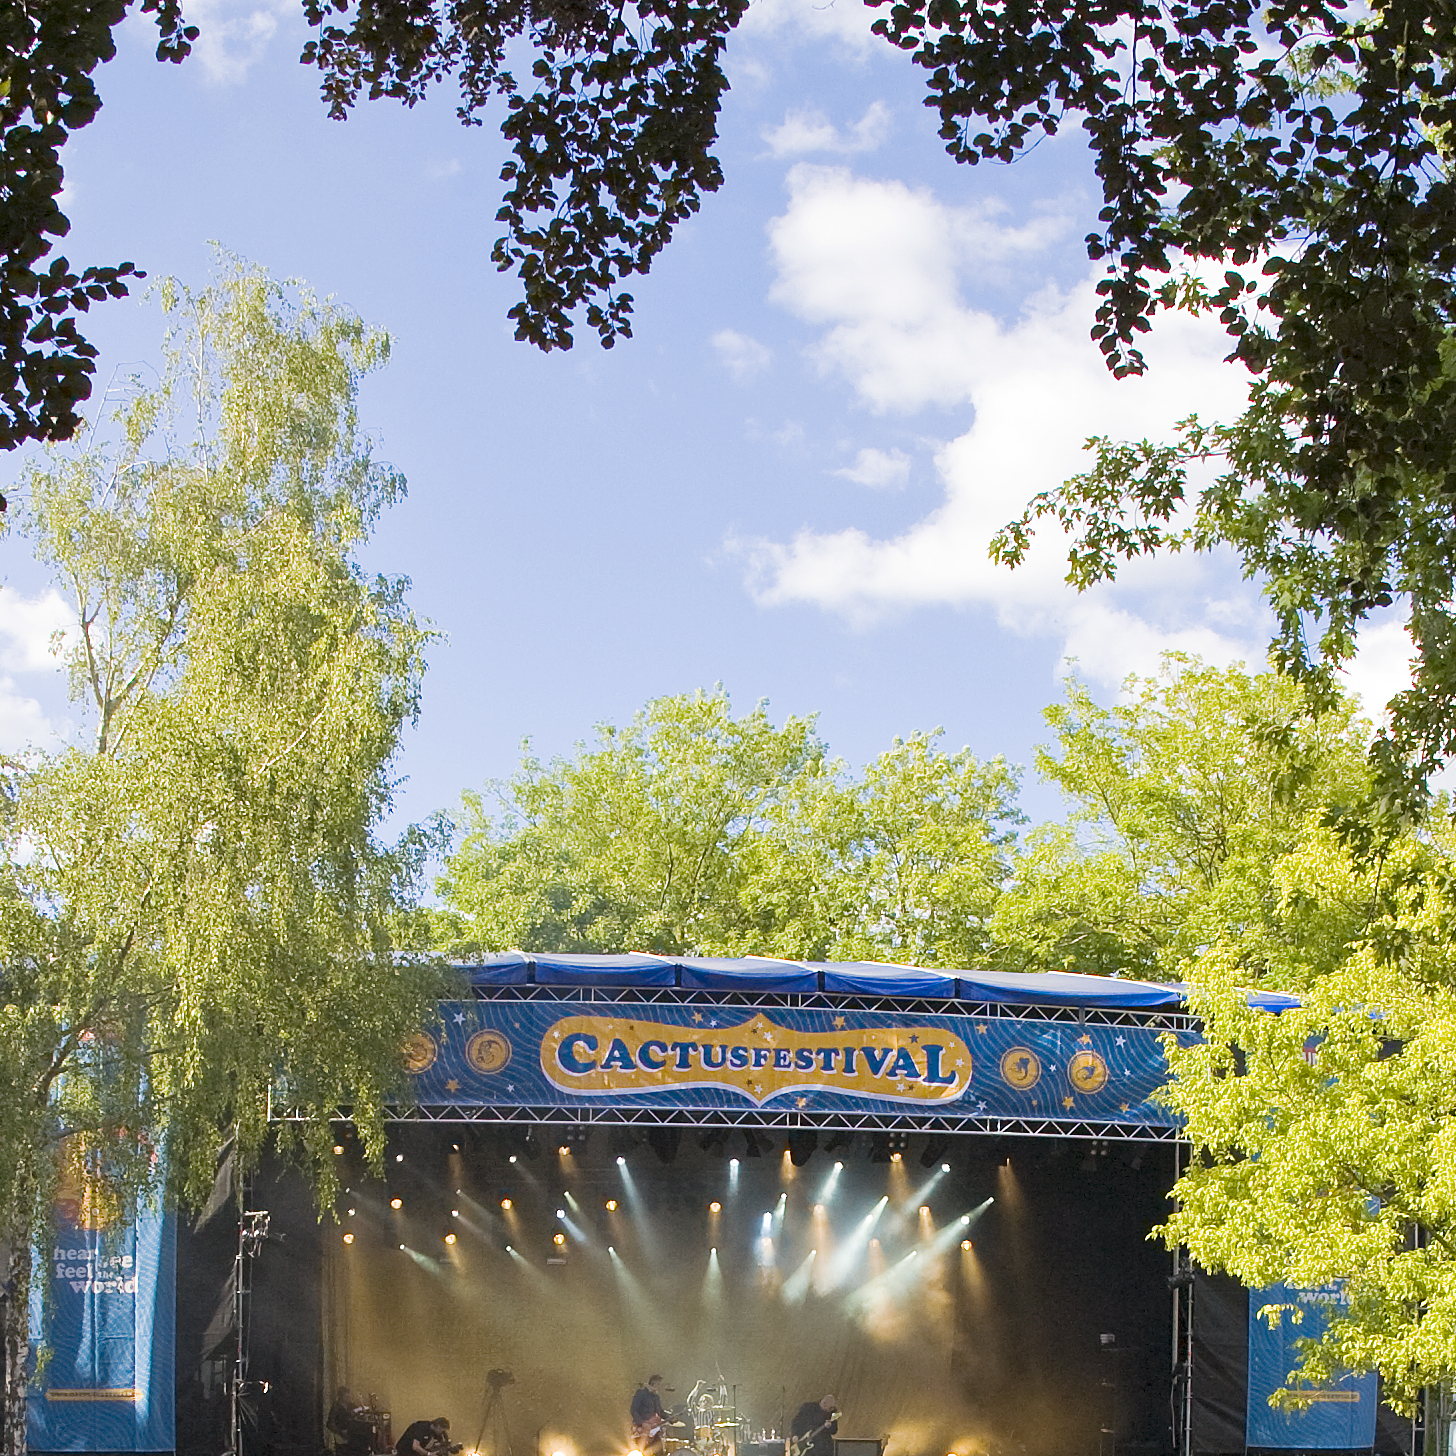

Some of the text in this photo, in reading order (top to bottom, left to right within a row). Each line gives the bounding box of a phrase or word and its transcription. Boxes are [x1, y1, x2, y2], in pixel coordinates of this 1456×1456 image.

[555, 1032, 960, 1087] CACTUSFESTIVAL
[53, 1245, 97, 1261] hear
[55, 1262, 94, 1280] feel
[69, 1275, 139, 1295] world
